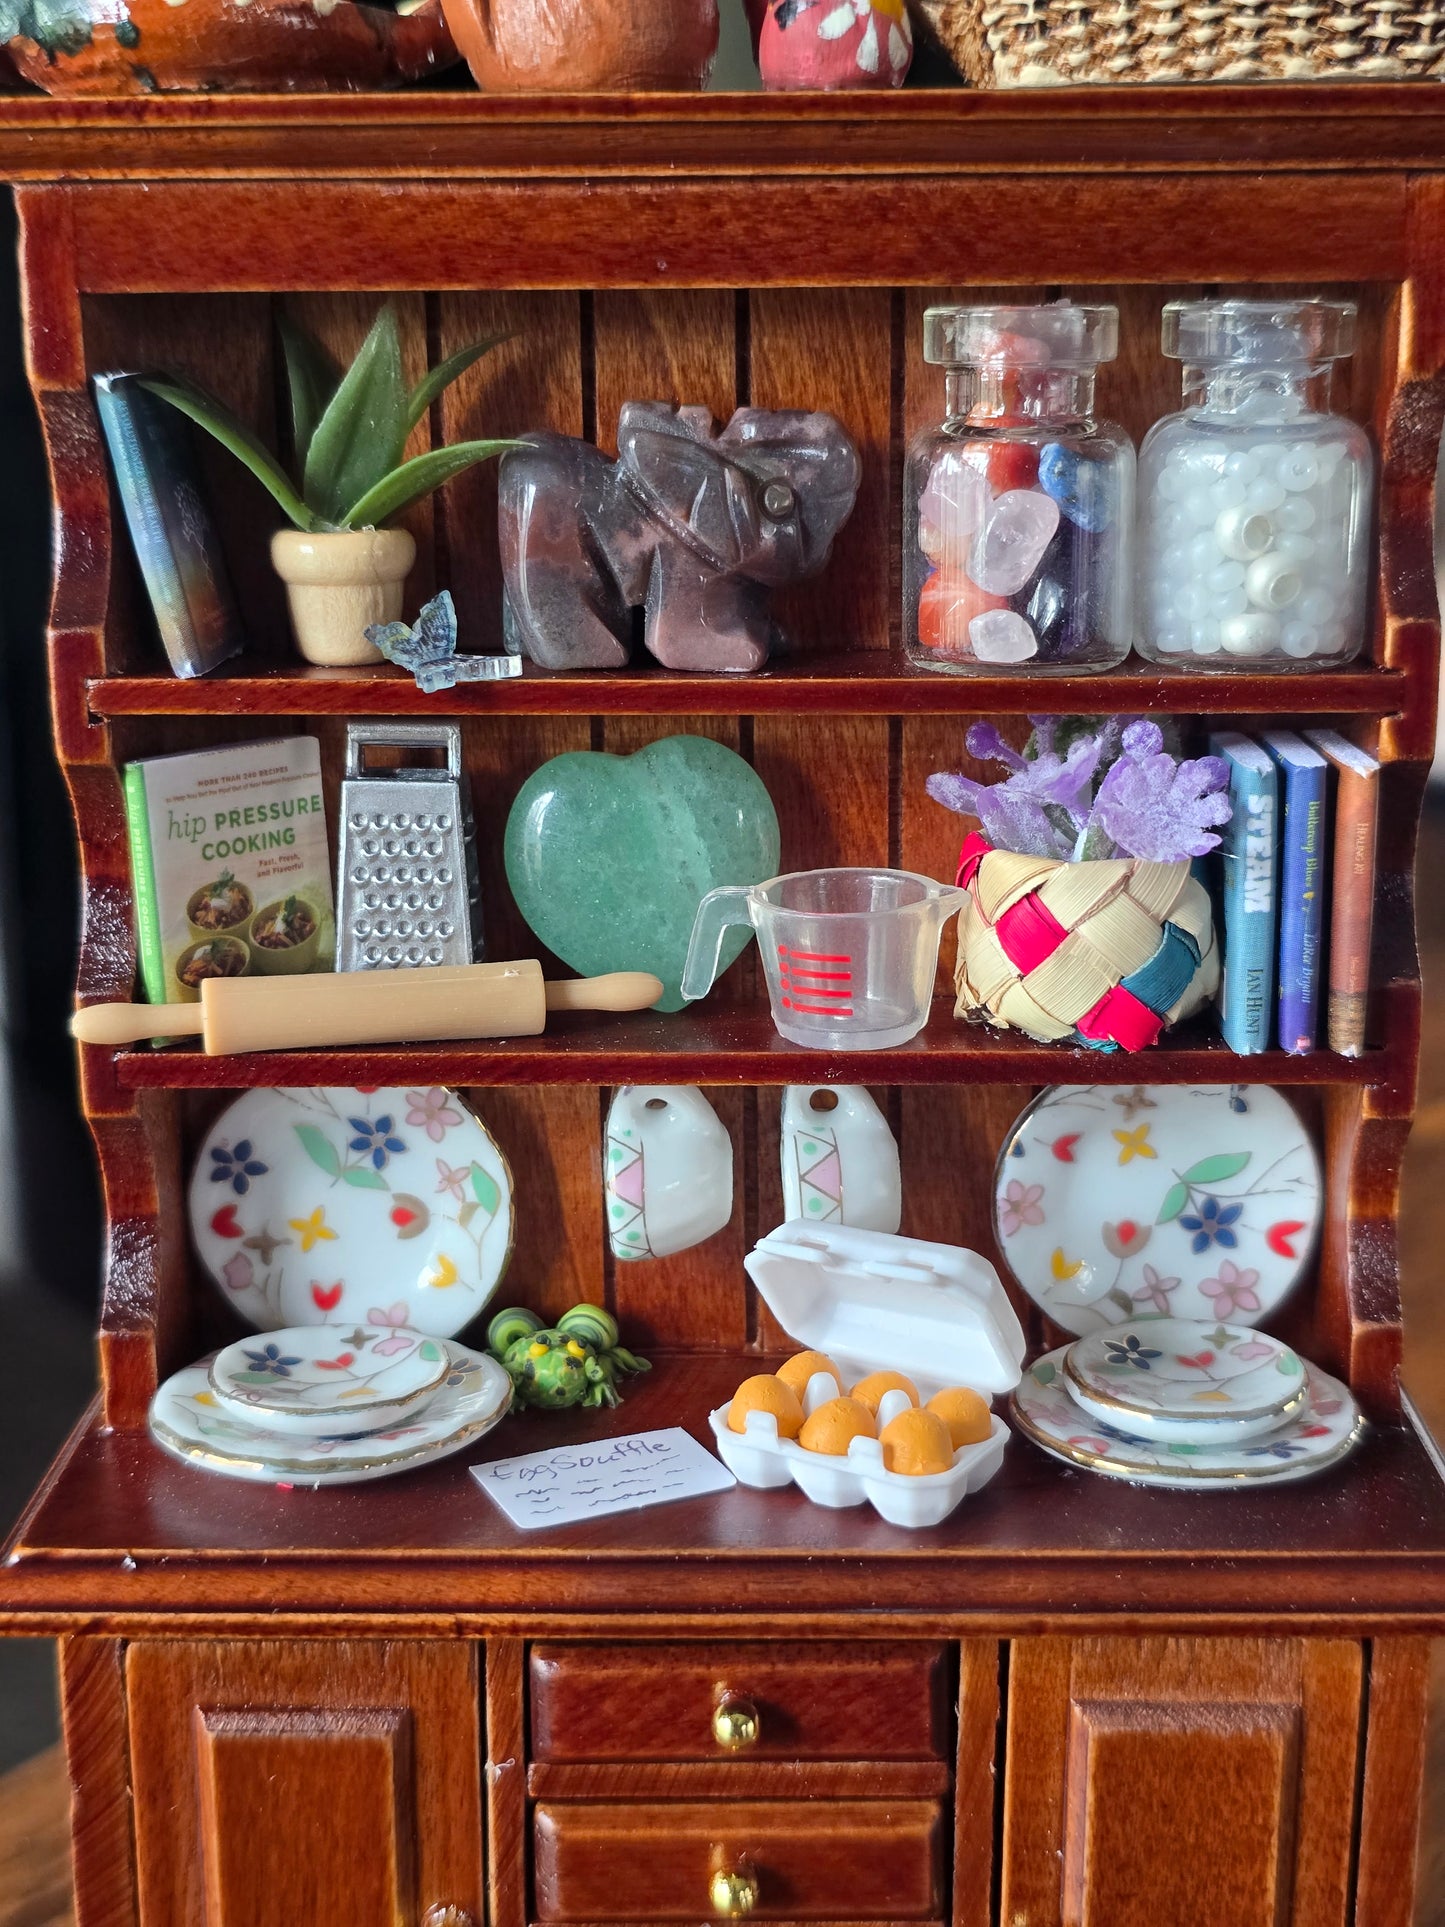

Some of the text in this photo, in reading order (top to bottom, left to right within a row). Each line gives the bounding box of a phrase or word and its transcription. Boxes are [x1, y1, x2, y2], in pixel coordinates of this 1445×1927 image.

[197, 777, 219, 787] MORE
[221, 773, 241, 783] THAN
[259, 766, 288, 777] RECIPES
[168, 794, 322, 843] hip PRESSURE
[202, 828, 296, 861] COOKING
[1244, 794, 1273, 913] STEAM
[1301, 800, 1320, 888] Buttercup Blues
[257, 861, 305, 878] and Flavorful
[259, 852, 301, 867] Fast, Fresh,
[133, 828, 147, 892] PRESSURE
[141, 897, 153, 956] COOKING
[1246, 968, 1264, 993] IAN
[489, 1463, 558, 1481] Egg
